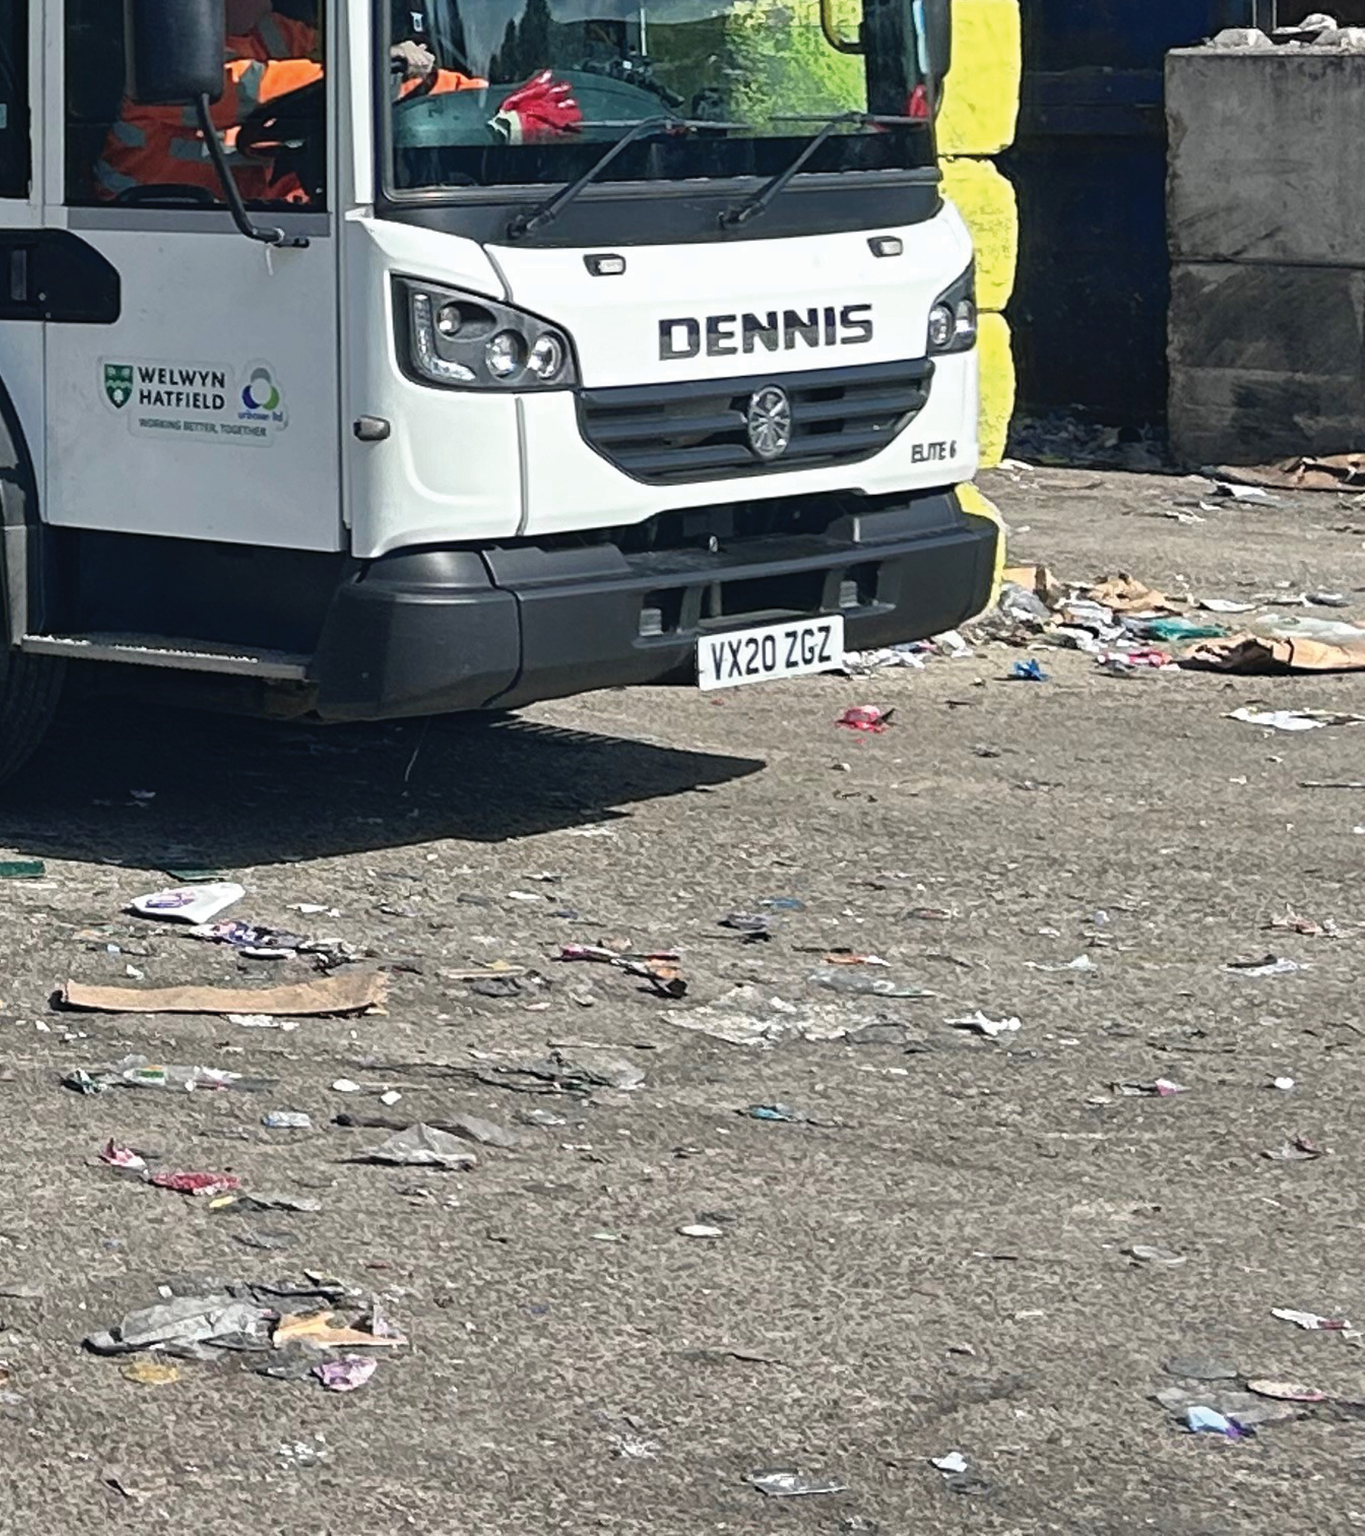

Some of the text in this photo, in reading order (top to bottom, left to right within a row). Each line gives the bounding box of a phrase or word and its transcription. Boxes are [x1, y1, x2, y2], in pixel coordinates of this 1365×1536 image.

[658, 303, 874, 361] DENNIS
[137, 366, 226, 389] WELWYN
[138, 388, 226, 411] HATFIELD
[138, 417, 182, 432] WORKING
[220, 423, 268, 437] TOGETHER
[910, 439, 958, 464] ELITE 6
[710, 624, 832, 681] VX20 ZGZ
